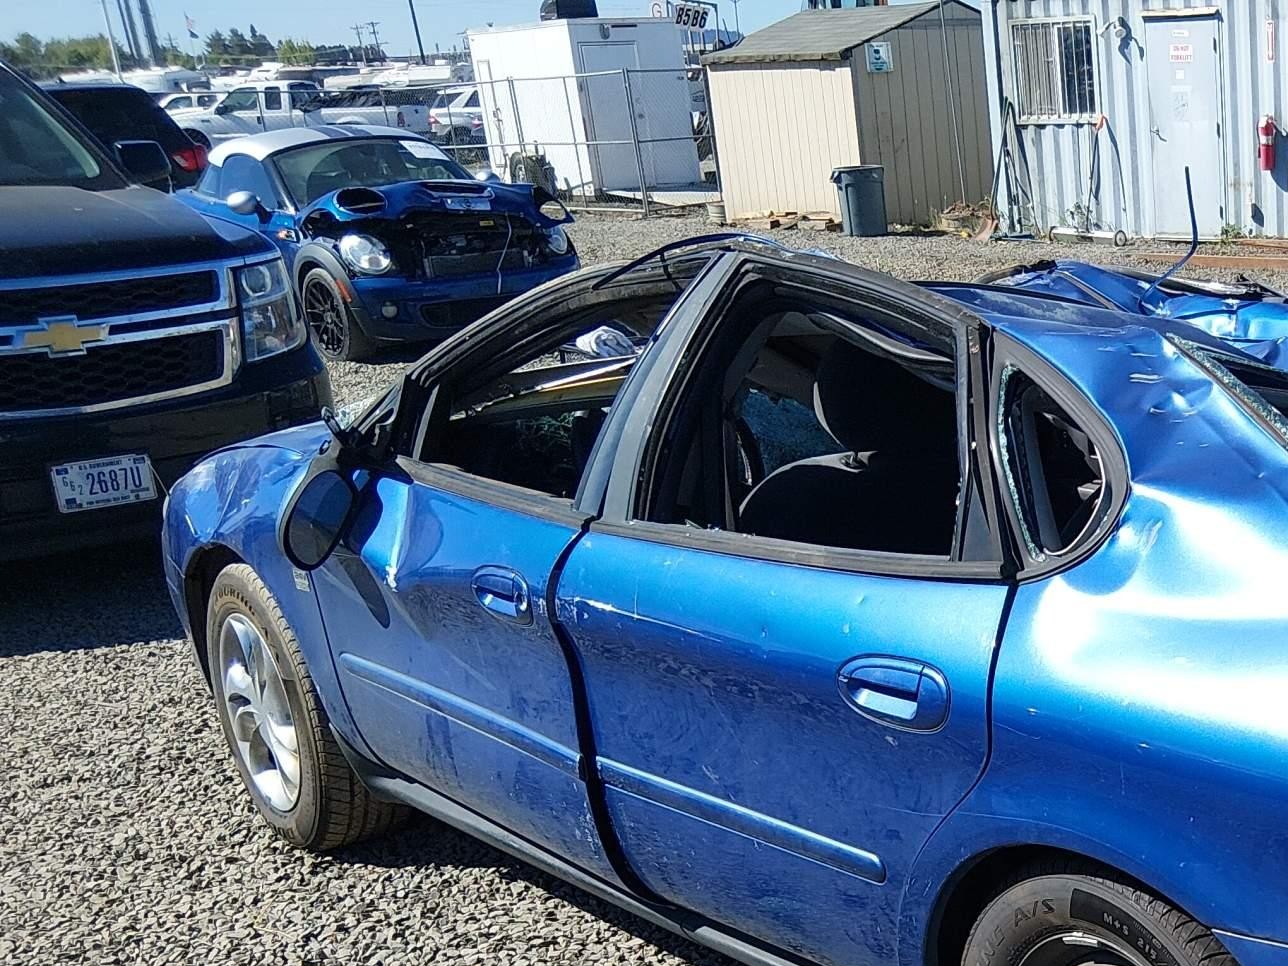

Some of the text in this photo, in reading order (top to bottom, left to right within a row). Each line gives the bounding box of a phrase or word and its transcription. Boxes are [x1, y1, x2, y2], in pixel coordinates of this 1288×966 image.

[86, 465, 142, 496] 2687U
[1014, 898, 1057, 928] A/S
[1102, 912, 1130, 937] M+S
